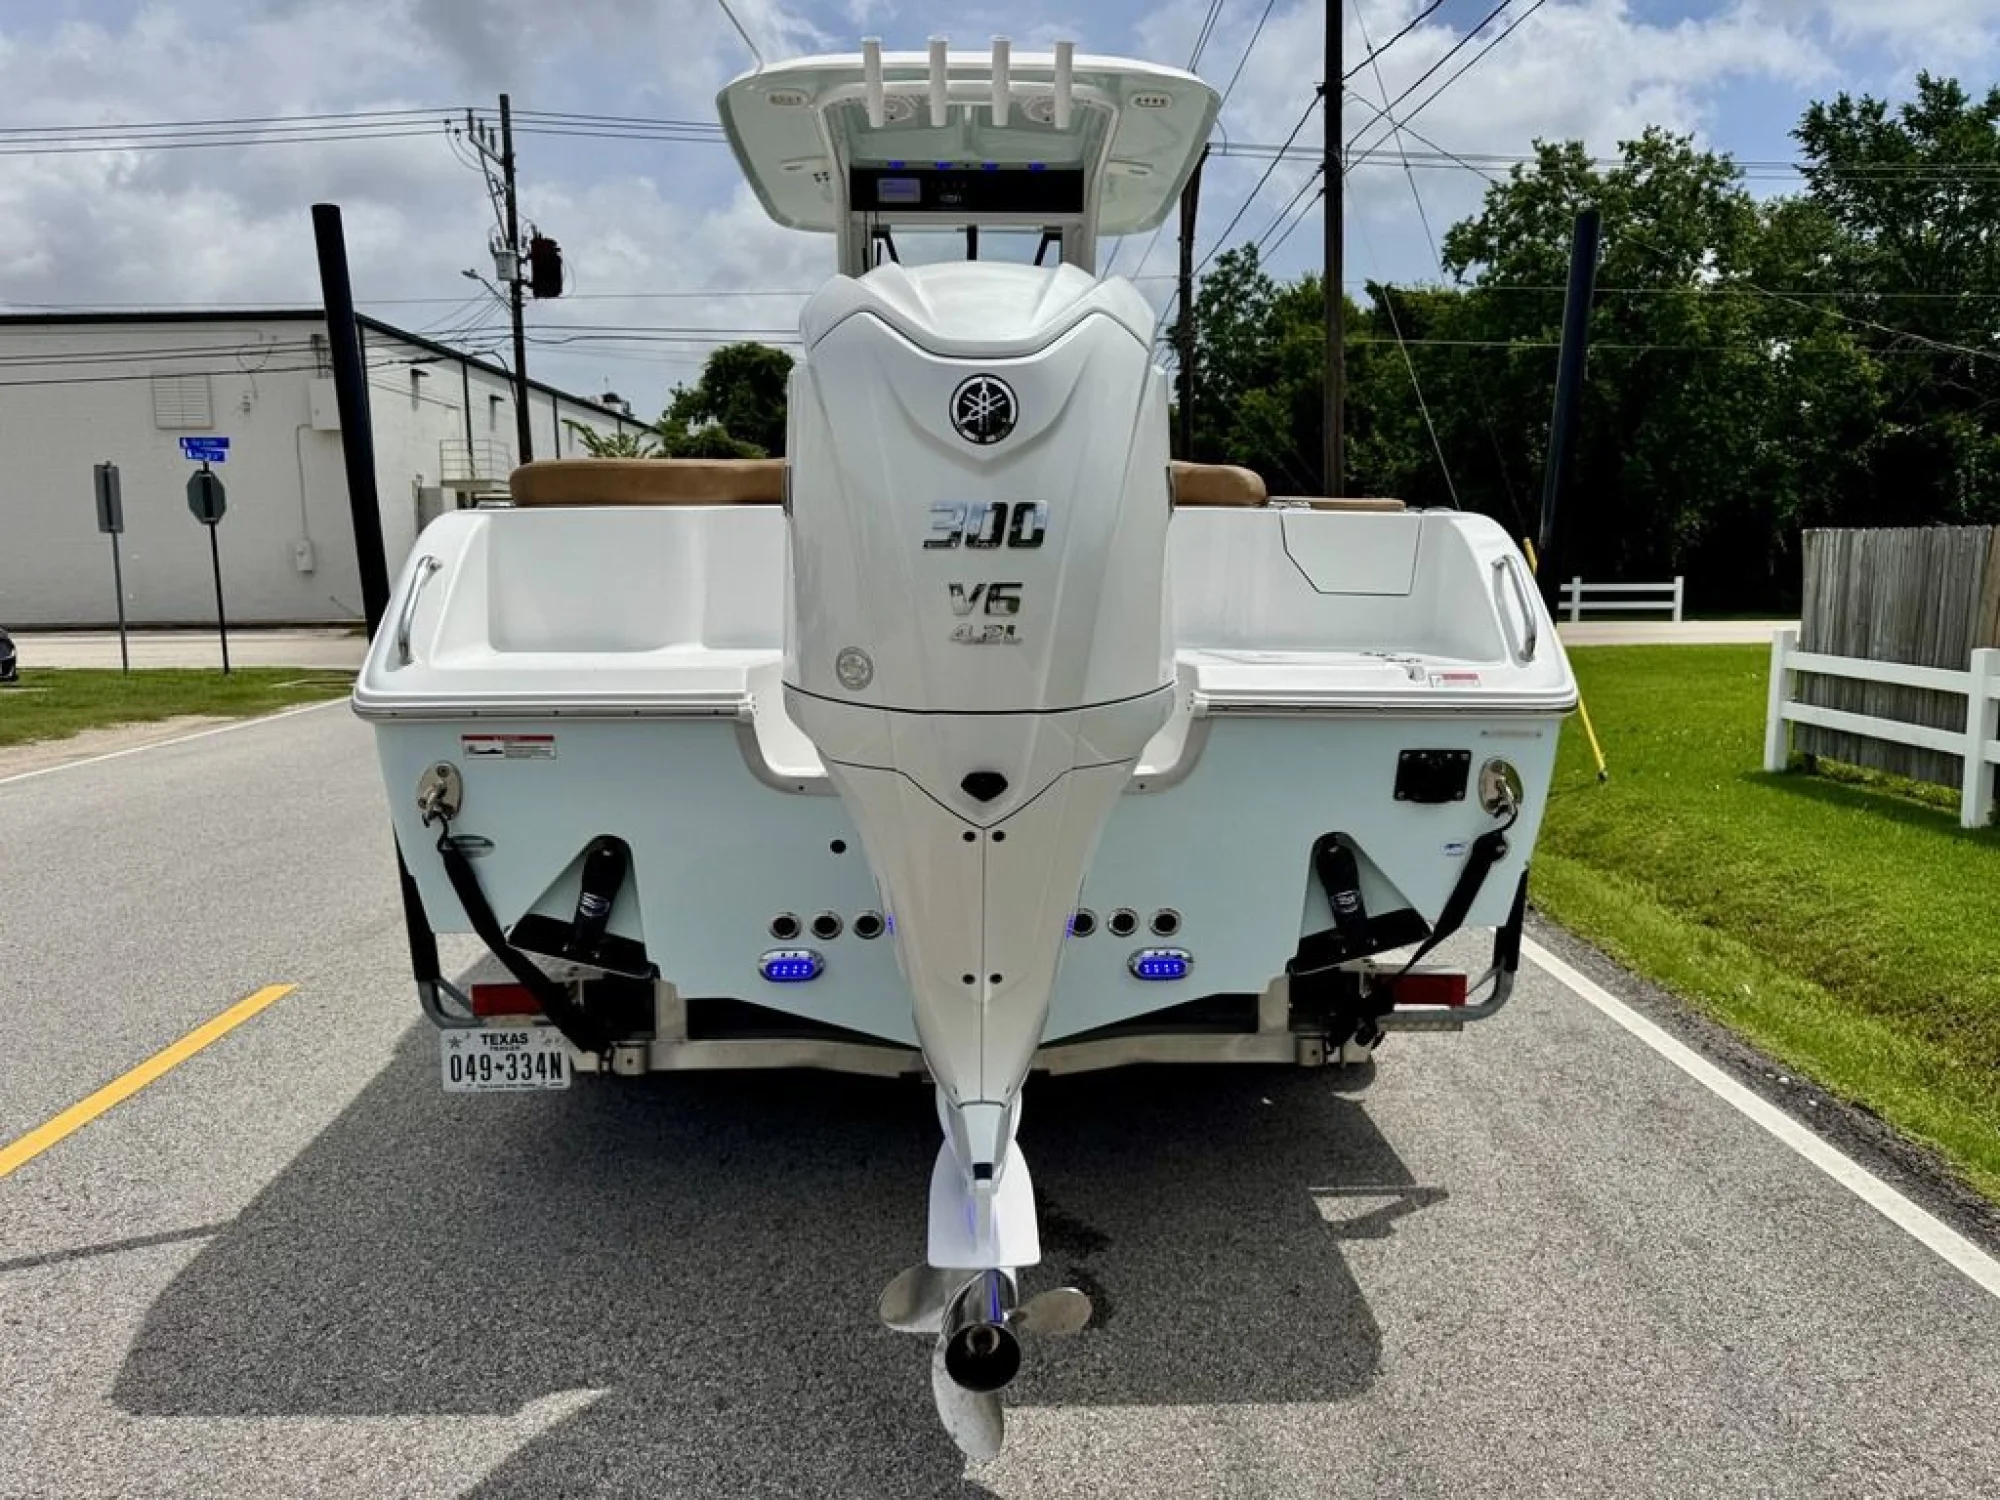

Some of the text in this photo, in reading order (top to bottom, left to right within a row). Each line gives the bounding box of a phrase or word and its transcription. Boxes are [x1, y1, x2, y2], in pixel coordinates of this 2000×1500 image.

[922, 500, 1048, 549] 300
[949, 582, 1023, 616] V6
[480, 1032, 528, 1046] TEXAS
